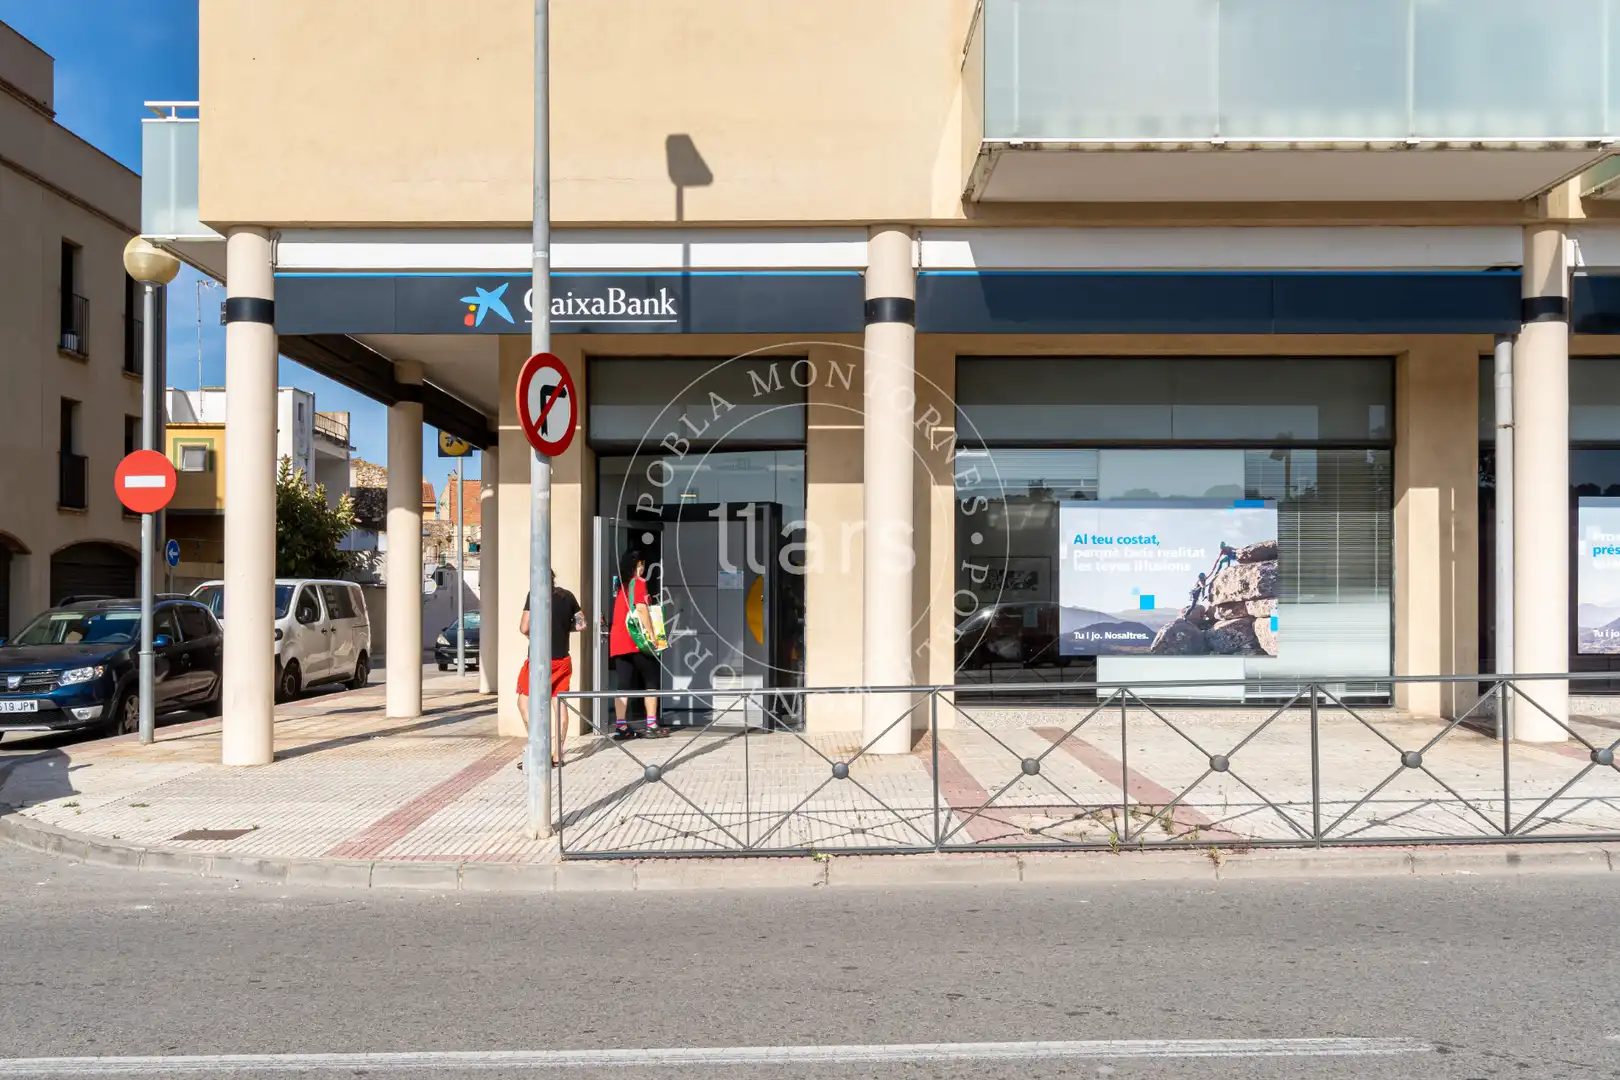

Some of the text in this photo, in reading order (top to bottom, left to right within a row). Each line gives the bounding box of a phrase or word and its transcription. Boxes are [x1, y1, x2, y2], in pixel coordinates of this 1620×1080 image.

[1073, 533, 1160, 546] Al teu costat,
[1073, 631, 1084, 640] Tu
[1090, 631, 1102, 642] jo.
[1104, 631, 1149, 640] Nosaltres.
[1593, 630, 1604, 638] Tu
[18, 702, 35, 711] JPW
